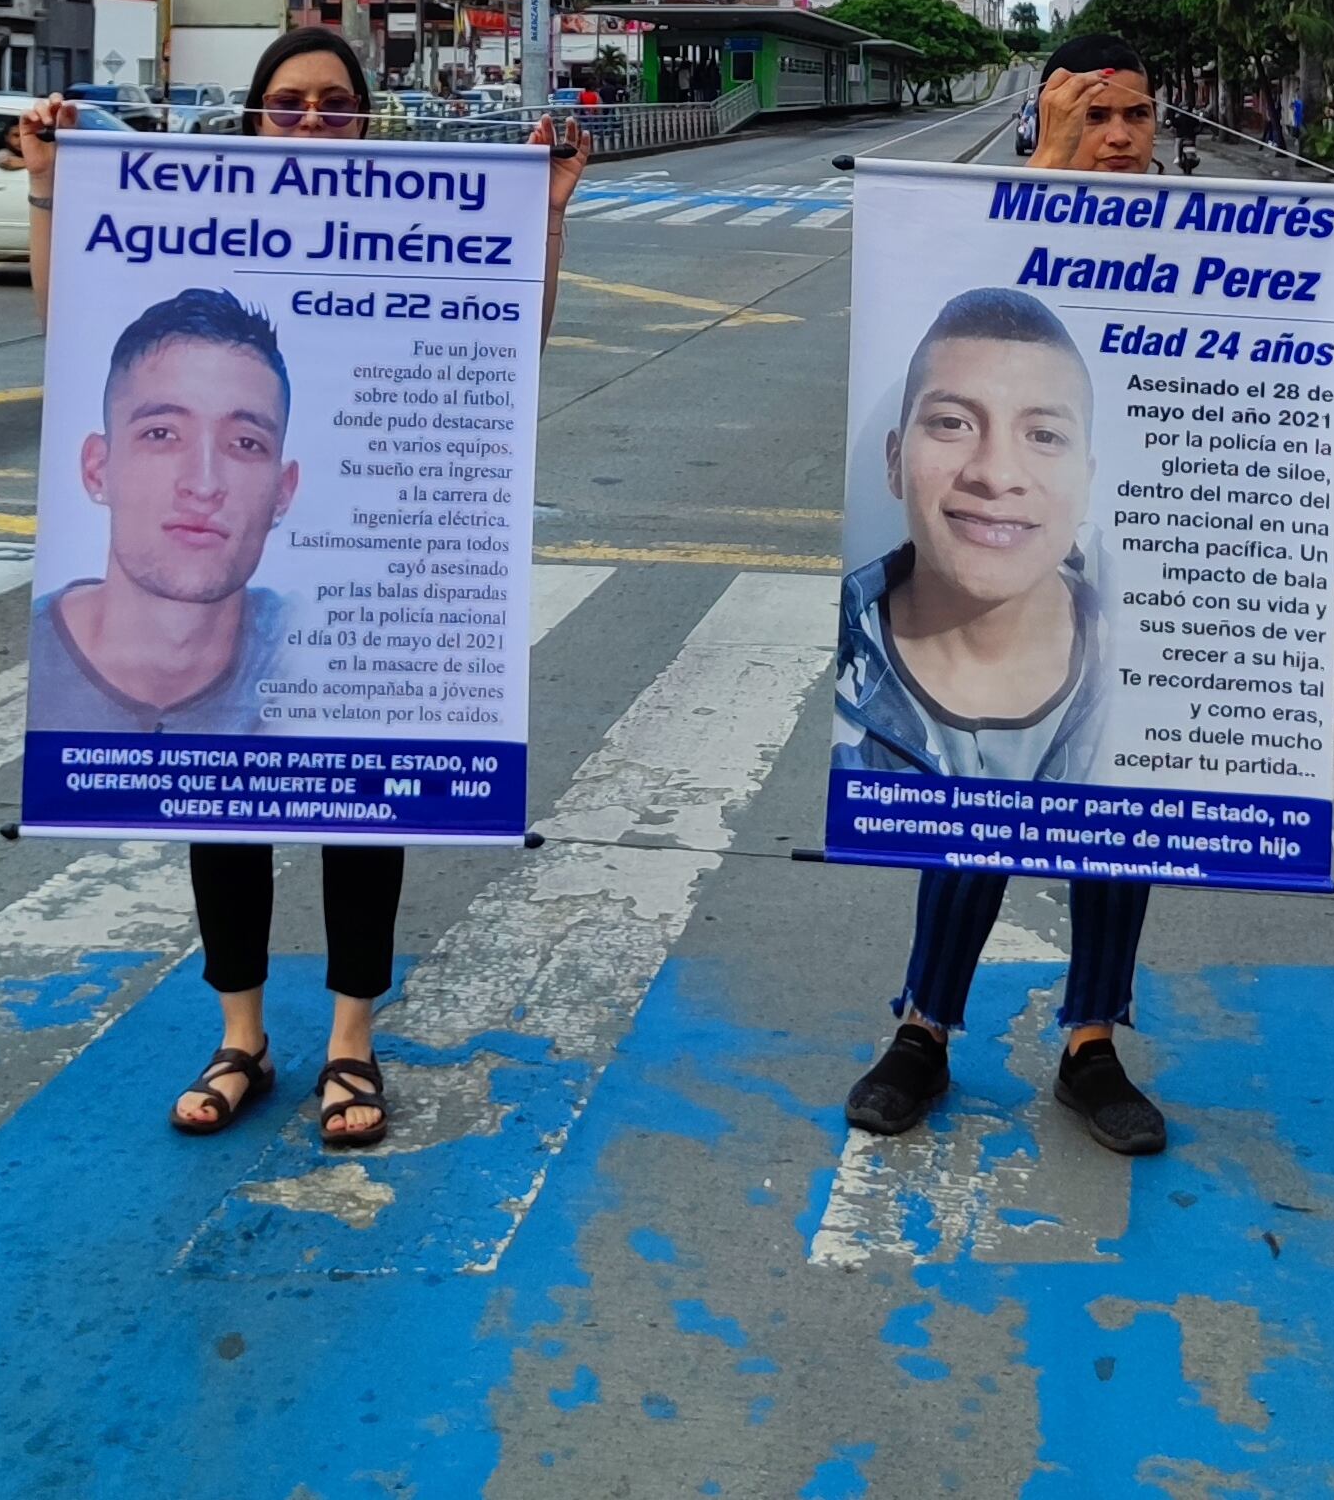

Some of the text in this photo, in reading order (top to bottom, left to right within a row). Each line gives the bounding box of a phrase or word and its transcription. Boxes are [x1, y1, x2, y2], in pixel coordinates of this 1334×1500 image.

[119, 151, 486, 210] Kevin Anthony
[990, 181, 1167, 229] Michael
[85, 214, 512, 264] Agudelo Jiménez
[1017, 247, 1321, 301] Aranda Perez
[291, 290, 520, 321] Edad 22 años
[413, 341, 516, 360] Fue un joven
[1101, 323, 1334, 366] Edad 24 años
[354, 366, 516, 384] entregado al deporte
[1127, 375, 1334, 402] Asesinado el 28 de
[354, 389, 514, 408] sobre todo al futbol,
[1127, 404, 1330, 428] mayo del año 2021
[62, 747, 497, 774] EXIGIMOS JUSTICIA POR PARTE DEL ESTADO, NO
[67, 774, 490, 798] QUEREMOS QUE LA MUERTE DE MI HIJO
[160, 799, 396, 820] QUEDE EN LA IMPUNIDAD.
[847, 781, 1310, 827] Exigimos justicia por parte del Estado, no
[853, 817, 1301, 859] queremos que la muerte de nuestro hijo
[945, 850, 1207, 878] quede en la impunidad.
